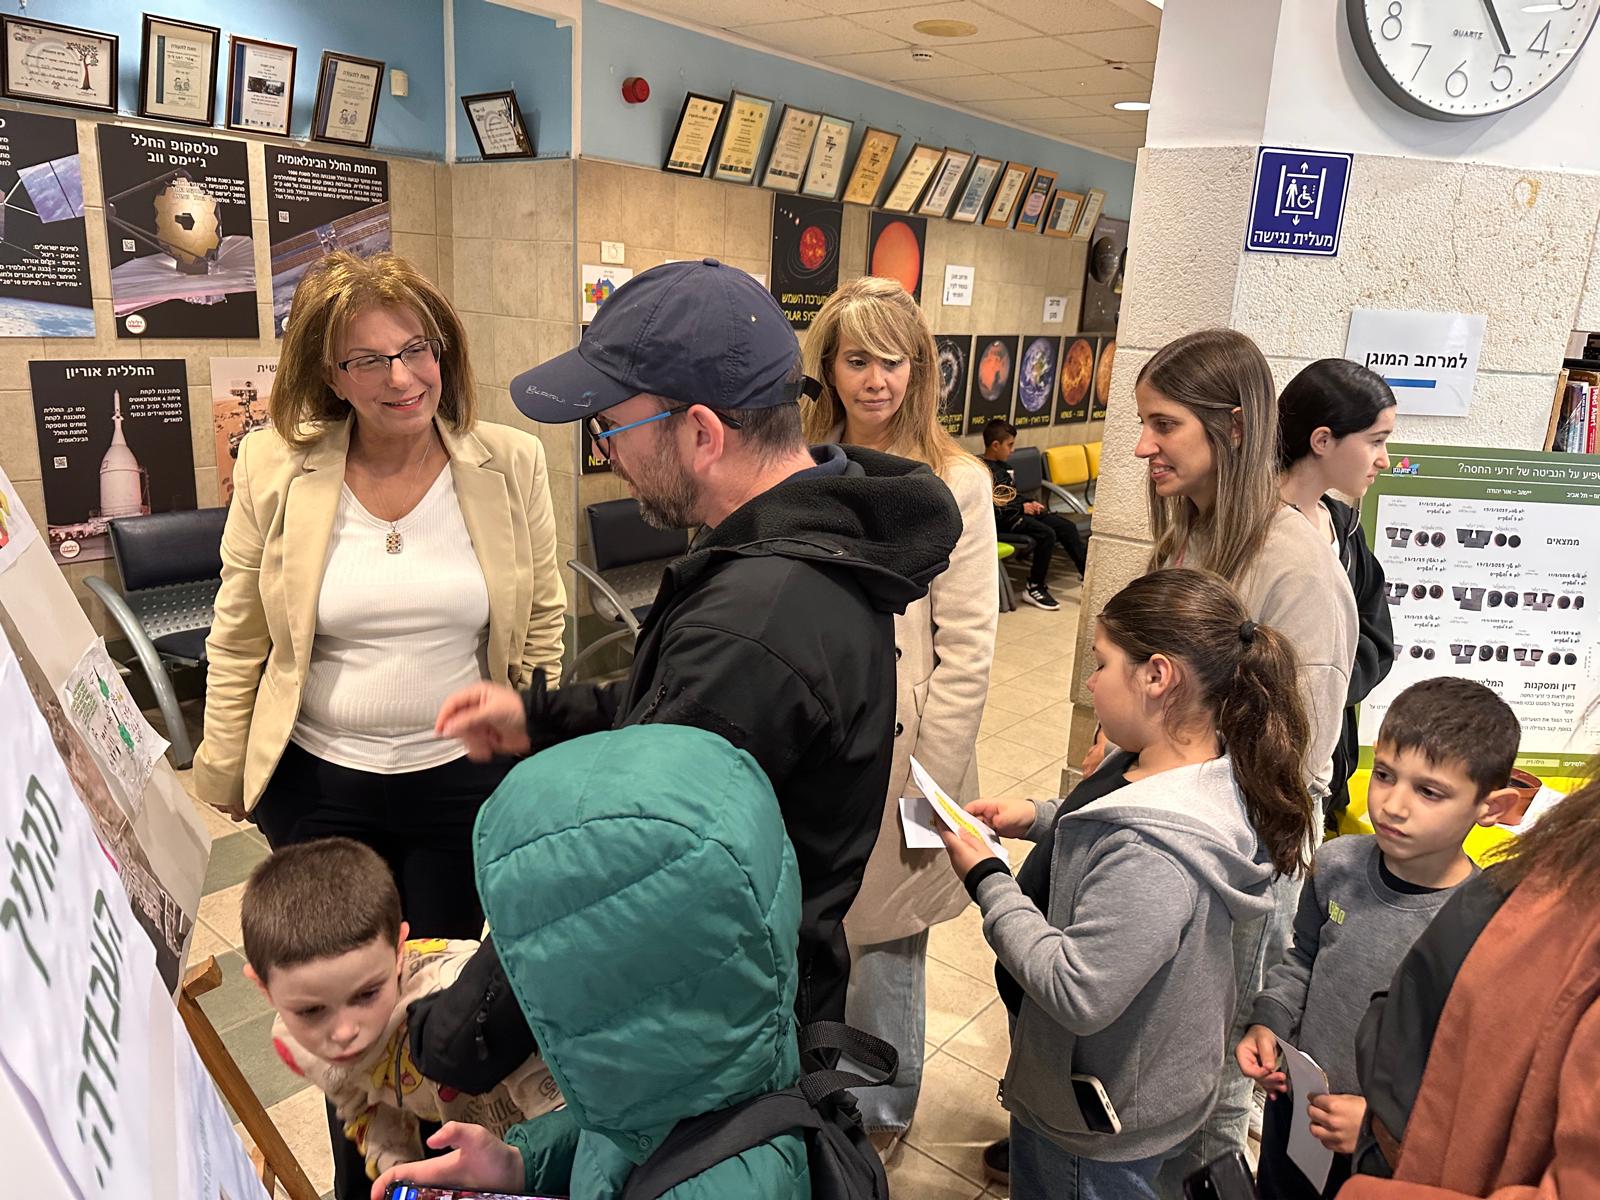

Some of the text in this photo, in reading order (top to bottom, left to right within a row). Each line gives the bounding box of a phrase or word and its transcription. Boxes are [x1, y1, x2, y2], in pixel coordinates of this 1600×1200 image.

[1381, 1, 1402, 40] 8
[1453, 29, 1483, 39] QUARTZ
[1527, 19, 1549, 58] 4
[1411, 43, 1432, 81] 7
[1446, 60, 1468, 97] 6
[1490, 54, 1516, 91] 5
[131, 133, 218, 155] טלסקופ החלל
[147, 152, 206, 168] ג'יימס ווב
[277, 154, 377, 175] תחנת החלל הבינלאומית
[1253, 229, 1333, 247] מעלית נגישה
[782, 293, 803, 304] השמש
[784, 310, 801, 321] OLAR
[1365, 350, 1467, 369] למרחב המוגן
[65, 365, 154, 379] החללית אוריון
[1590, 388, 1599, 426] Red Alert
[1458, 462, 1492, 475] החסה?
[1494, 465, 1514, 475] זרעי
[1516, 465, 1530, 476] של
[1532, 468, 1566, 478] הנביטה
[1568, 468, 1580, 479] על
[1546, 537, 1580, 546] ממצאים
[1473, 678, 1503, 687] המלצ
[1524, 681, 1576, 692] דיון ומסקנות
[0, 774, 63, 988] תהליך
[76, 889, 123, 1189] העבודה:
